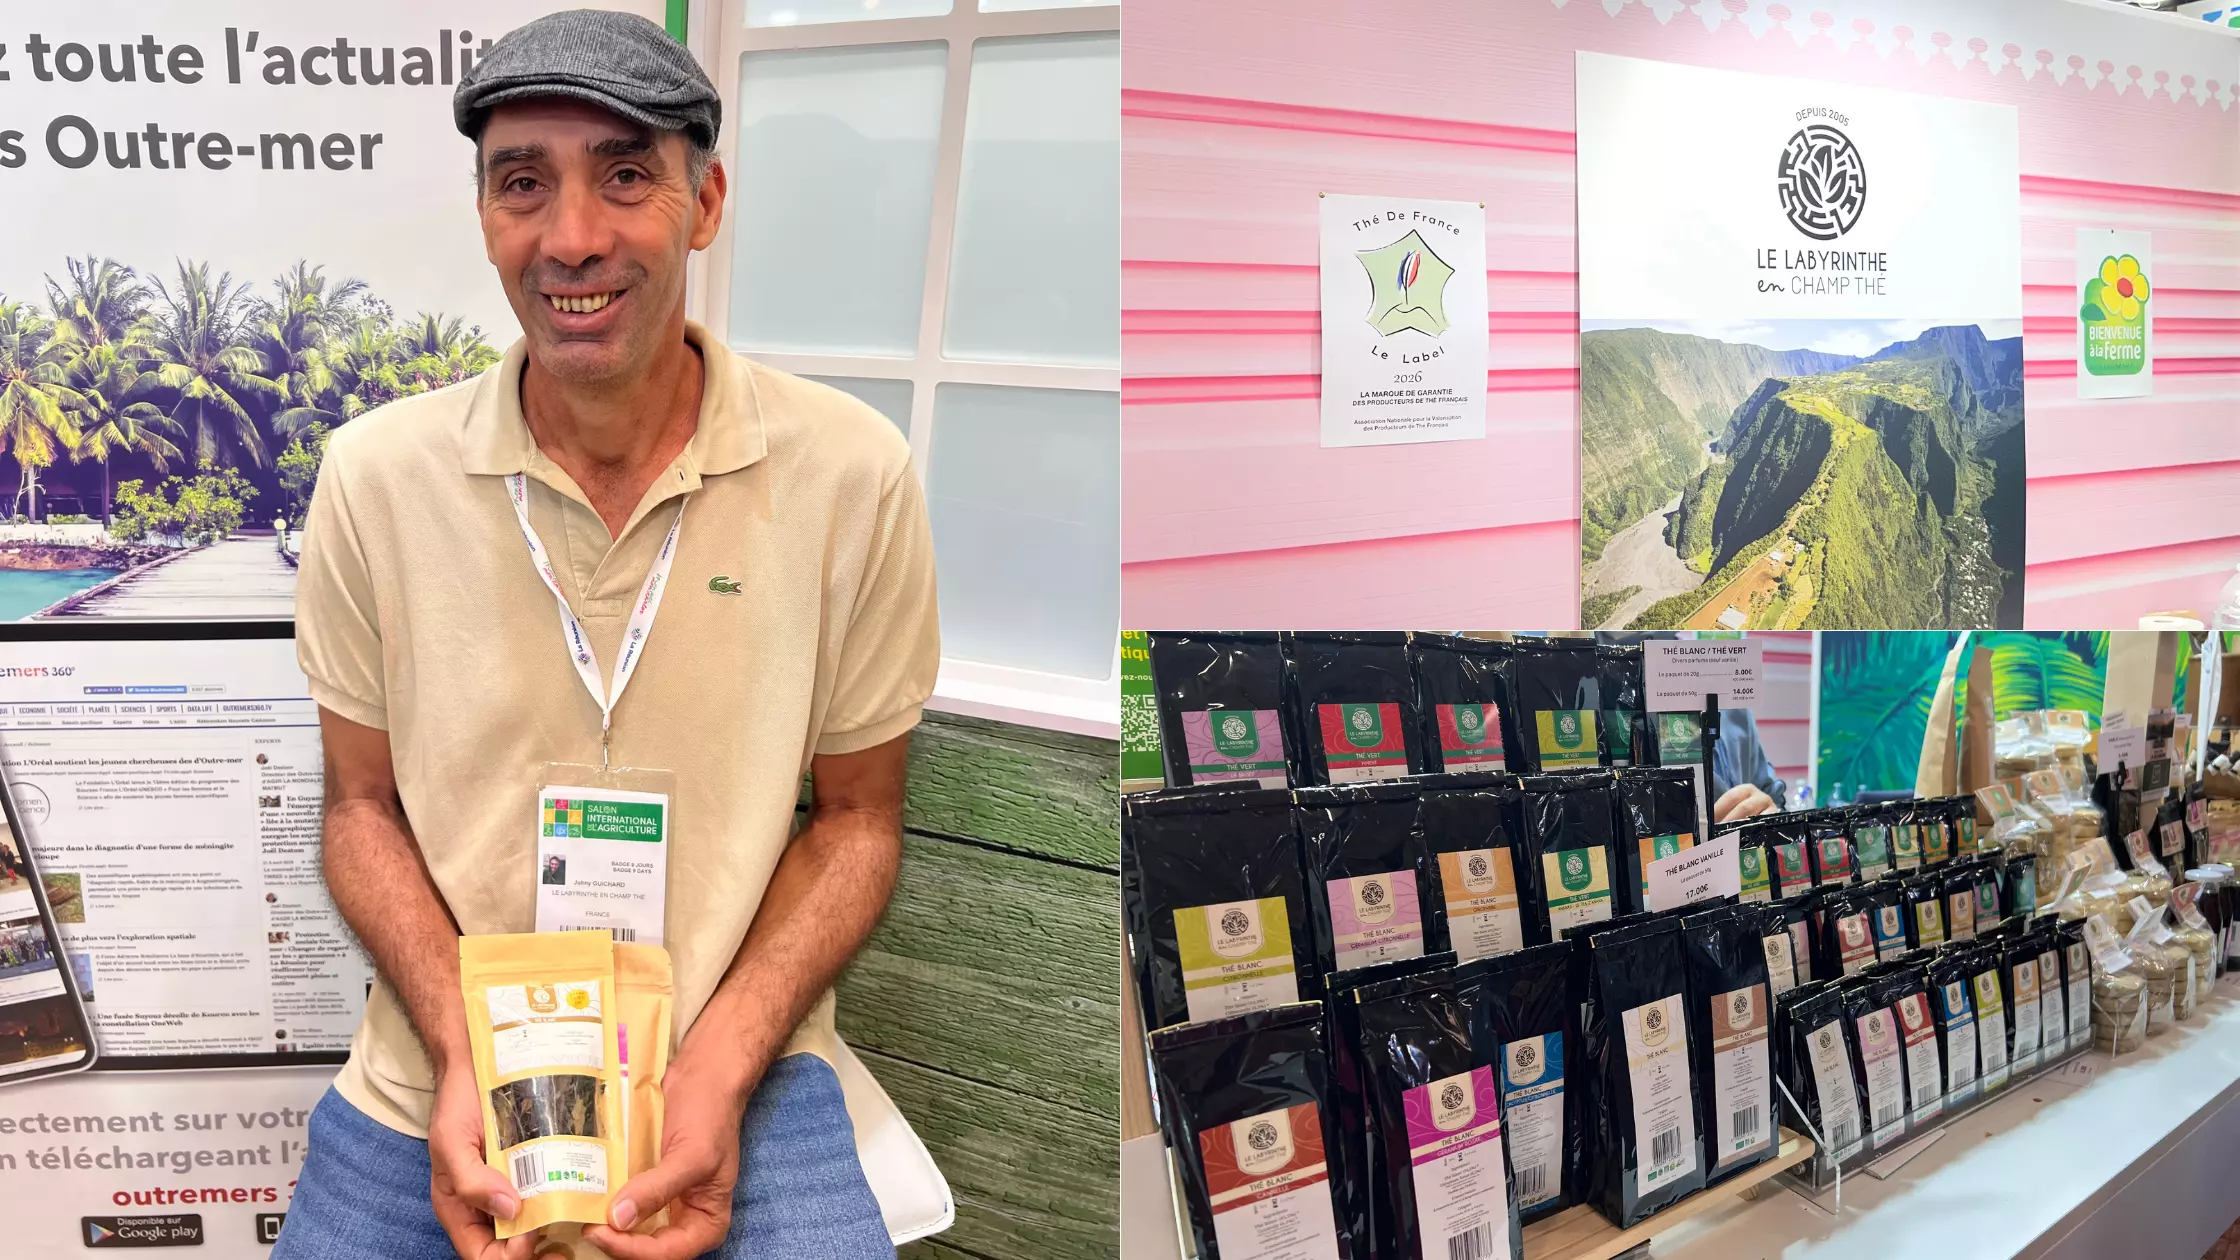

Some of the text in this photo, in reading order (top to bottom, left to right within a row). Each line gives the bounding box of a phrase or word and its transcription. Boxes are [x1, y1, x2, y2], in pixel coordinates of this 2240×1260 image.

[26, 33, 204, 85] toute
[1795, 107, 1850, 127] DEPUIS 2005
[46, 114, 384, 171] Outre-mer
[1352, 211, 1461, 236] Thé De France
[1757, 248, 1887, 272] LE LABYRINTHE
[1757, 272, 1887, 296] en CHAMP THÉ
[2089, 325, 2142, 341] BIENVENUE
[1371, 345, 1445, 364] Le Label
[2089, 341, 2141, 360] à la ferme
[1393, 370, 1422, 384] 2026
[1360, 391, 1370, 399] LA
[1371, 390, 1404, 398] MARQUE
[1417, 388, 1453, 396] GARANTIE
[1366, 398, 1414, 406] PRODUCTEURS
[1663, 646, 1678, 655] THÉ
[1679, 647, 1706, 655] BLANC
[1712, 645, 1727, 654] THÉ
[1728, 646, 1747, 654] VERT
[121, 705, 147, 713] SCIENCES
[187, 705, 201, 713] DATA
[23, 758, 53, 766] L'Oréal
[101, 758, 128, 767] jeunes
[128, 757, 178, 765] chercheuses
[178, 757, 193, 765] des
[1227, 763, 1238, 771] THÉ
[587, 804, 617, 814] SALON
[587, 814, 657, 826] INTERNATIONAL
[591, 824, 658, 835] L'AGRICULTURE
[31, 844, 64, 853] majeure
[94, 843, 135, 852] diagnostic
[135, 843, 158, 851] d'une
[194, 842, 235, 851] méningite
[1665, 848, 1724, 877] THÉ BLANC VANILLE
[592, 880, 625, 888] GUICHARD
[560, 890, 598, 898] LABYRINTHE
[1685, 884, 1709, 899] 17.00€
[585, 910, 610, 918] FRANCE
[1365, 904, 1391, 912] LABYRINTHE
[81, 933, 98, 942] plus
[117, 932, 165, 942] l'exploration
[166, 932, 197, 941] spatiale
[1225, 934, 1258, 944] LABYRINTHE
[1362, 927, 1395, 939] THÉ BLANC
[1377, 933, 1410, 945] CITRONNELLE
[1222, 961, 1264, 973] THÉ BLANC
[1222, 970, 1264, 982] CITRONNELLE
[1524, 1086, 1542, 1095] BLANC
[0, 1110, 165, 1134] ectement
[174, 1111, 227, 1131] sur
[1441, 1130, 1476, 1147] THÉ BLANC
[1252, 1145, 1287, 1160] LABYRINTHE
[26, 1145, 271, 1174] téléchargeant
[1249, 1173, 1294, 1192] THÉ BLANC
[112, 1187, 278, 1207] outremers
[117, 1216, 182, 1227] Disponible sur
[117, 1225, 199, 1241] Google play
